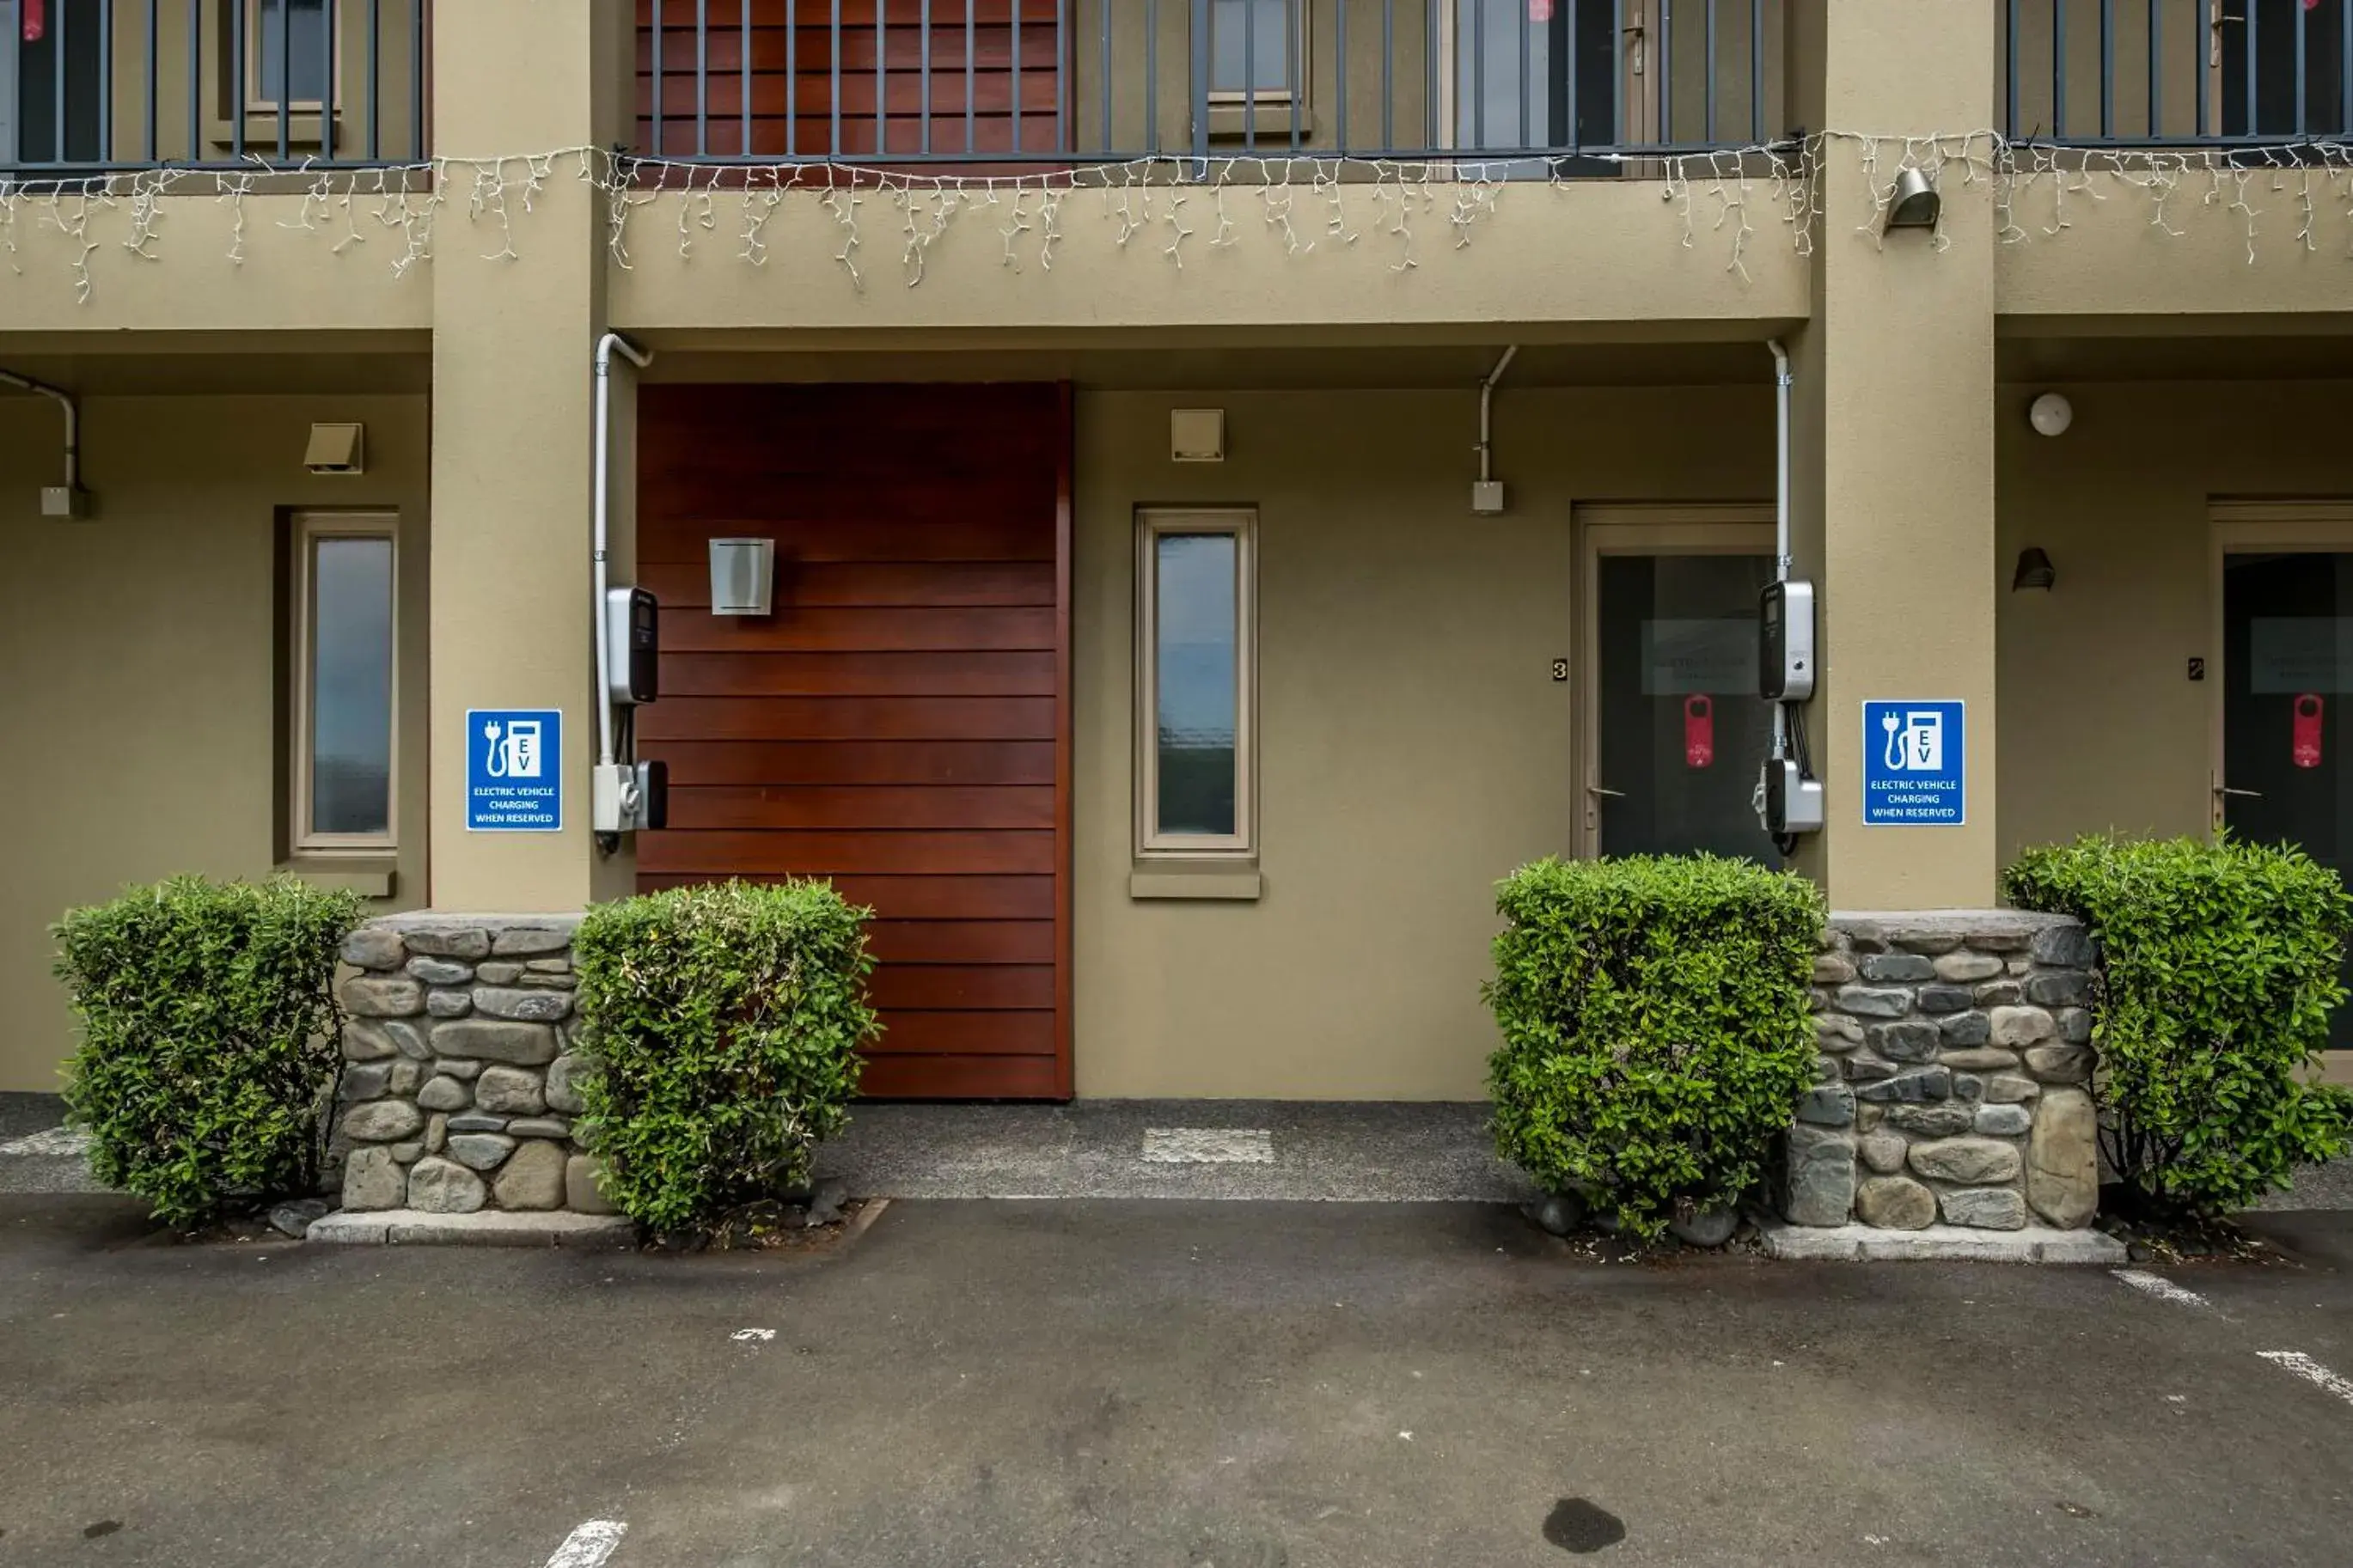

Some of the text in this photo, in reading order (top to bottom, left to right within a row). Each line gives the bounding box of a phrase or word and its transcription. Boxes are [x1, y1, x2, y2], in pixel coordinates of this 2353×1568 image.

[1553, 662, 1567, 679] 3
[1871, 780, 1957, 790] ELECTRIC VEHICLE
[474, 787, 554, 796] ELECTRIC VEHICLE
[1887, 795, 1940, 803] CHARGING
[489, 801, 539, 809] CHARGING
[1873, 808, 1955, 817] WHEN RESERVED
[475, 814, 553, 822] WHEN RESERVED
